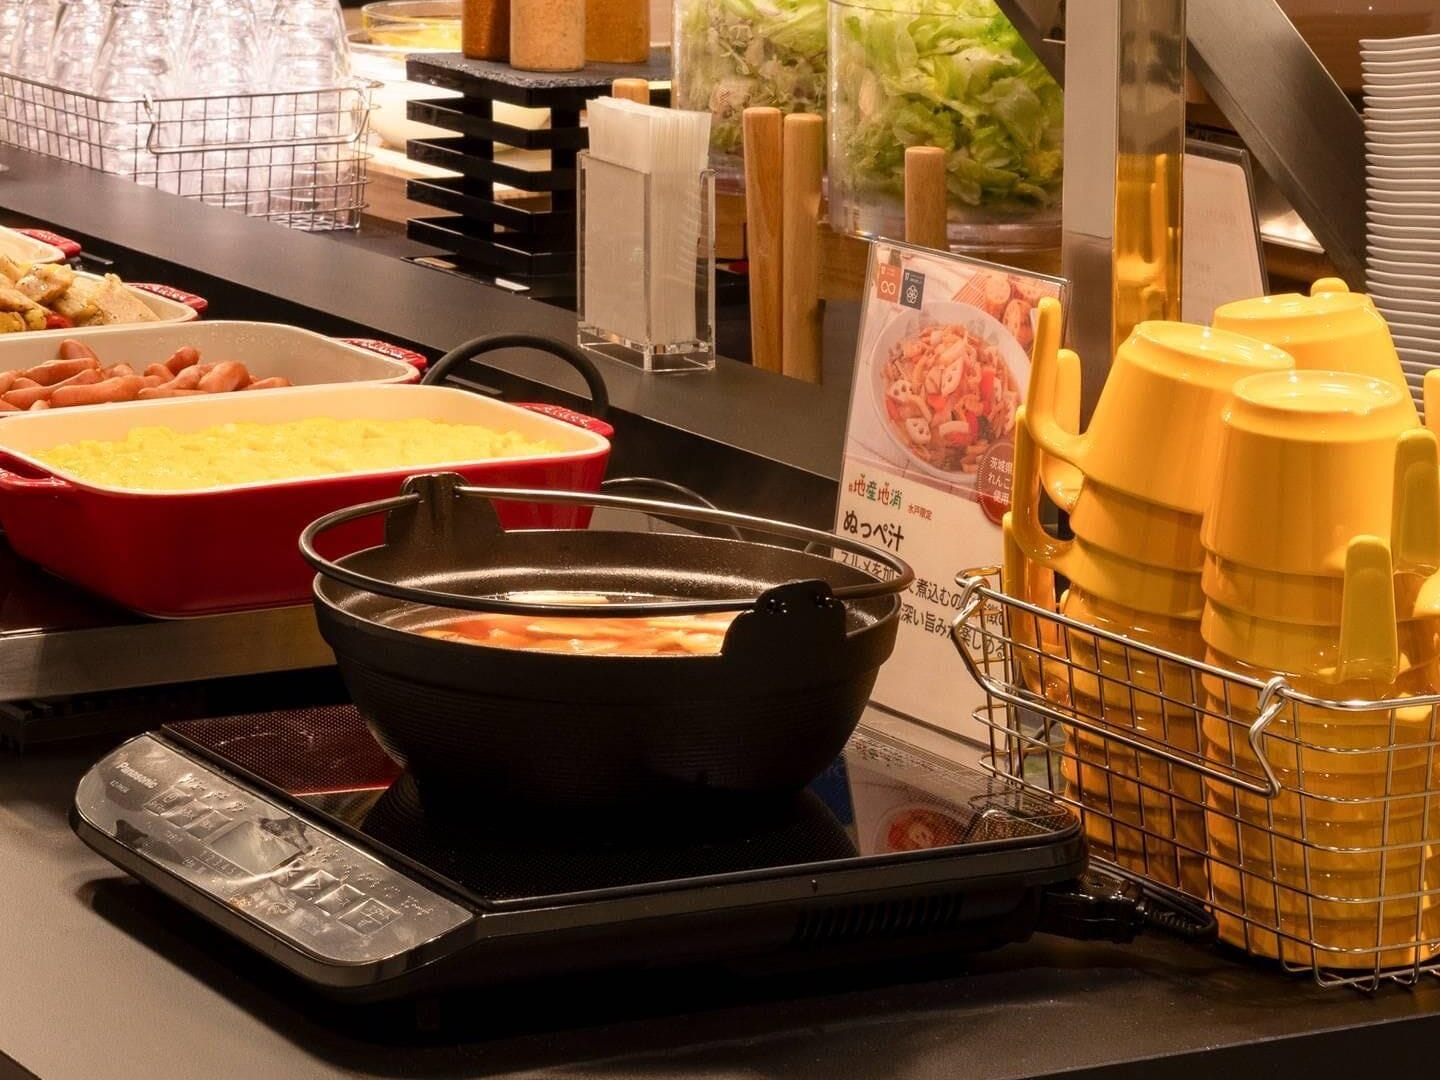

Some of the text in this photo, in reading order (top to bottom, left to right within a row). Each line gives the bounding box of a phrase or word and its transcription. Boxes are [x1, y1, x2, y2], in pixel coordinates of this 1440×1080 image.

[843, 510, 905, 552] ぬっぺ汁
[116, 762, 159, 789] Panasonic
